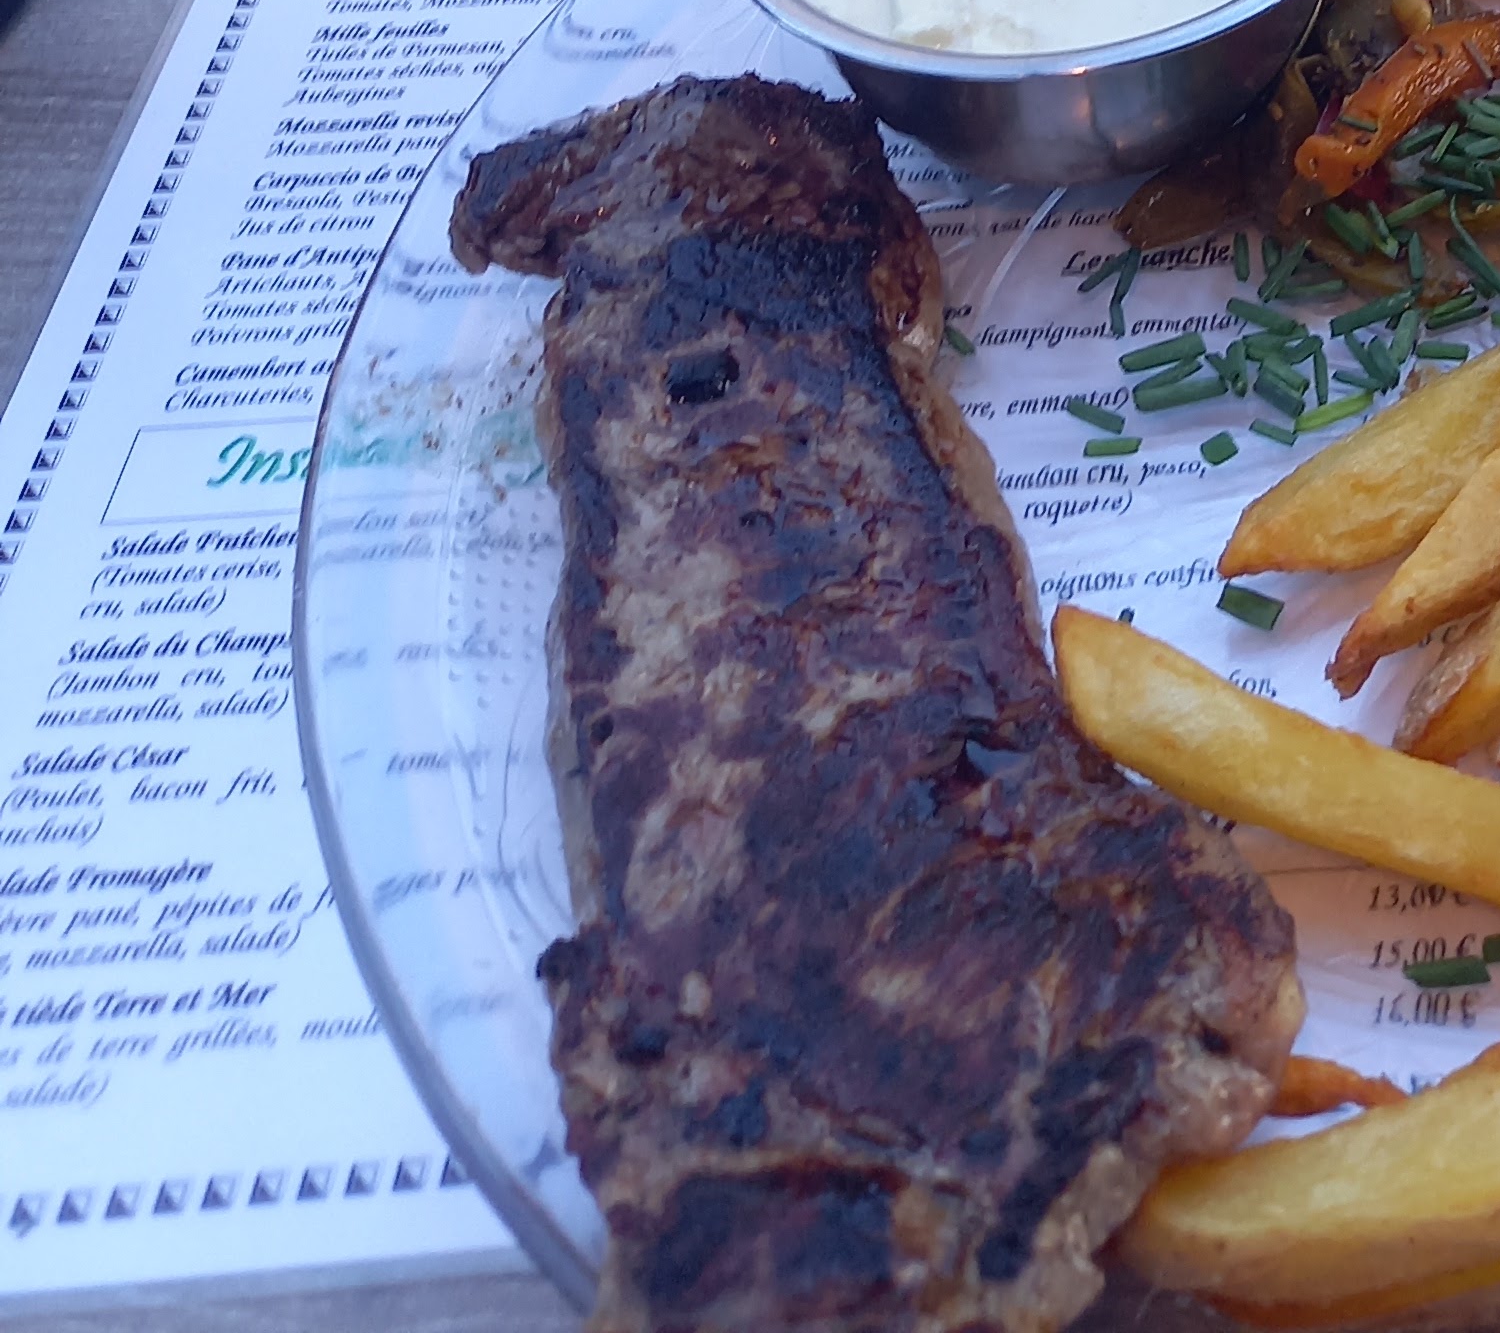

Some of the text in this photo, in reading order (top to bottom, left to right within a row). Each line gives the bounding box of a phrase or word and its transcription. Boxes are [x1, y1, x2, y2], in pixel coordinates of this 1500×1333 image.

[311, 20, 451, 45] Mille feuilles
[371, 41, 397, 61] de
[400, 38, 505, 58] Parmesan,
[298, 64, 385, 86] Tomates
[283, 83, 407, 108] Aubergines
[273, 112, 402, 137] Mozzarella
[264, 136, 392, 160] Mozzarella
[253, 166, 362, 194] Carpaccio
[364, 162, 393, 184] de
[244, 187, 343, 213] Bresaola,
[230, 212, 376, 240] Jus de citron
[204, 271, 337, 299] Artichauts,
[201, 299, 300, 321] Tomates
[190, 325, 293, 348] Poivrons
[174, 355, 306, 387] Camembert
[163, 382, 315, 413] Charcuteries,
[1086, 462, 1130, 486] cru,
[1023, 490, 1133, 527] roquette)
[101, 530, 191, 561] Salade
[91, 557, 283, 595] (Tomates cerise,
[1040, 569, 1138, 601] oignons
[79, 587, 228, 621] cru, salade)
[58, 632, 150, 666] Salade
[153, 630, 191, 659] du
[46, 665, 161, 703] (Jambon
[180, 662, 227, 690] cru,
[35, 687, 290, 730] mozzarella, salade)
[10, 742, 192, 780] Salade César
[0, 767, 278, 820] (Poulet, bacon frit,
[66, 856, 214, 895] Fromagère
[62, 898, 141, 938] pané,
[153, 891, 259, 929] pépites
[267, 881, 303, 914] de
[24, 919, 302, 970] mozzarella, salade)
[1369, 933, 1478, 970] 15,00 €
[11, 978, 278, 1028] tiède Terre et Mer
[1373, 990, 1451, 1027] 16,00
[34, 1032, 73, 1066] de
[87, 1032, 158, 1063] terre
[163, 1016, 278, 1063] grillées,
[4, 1068, 112, 1108] salade)
